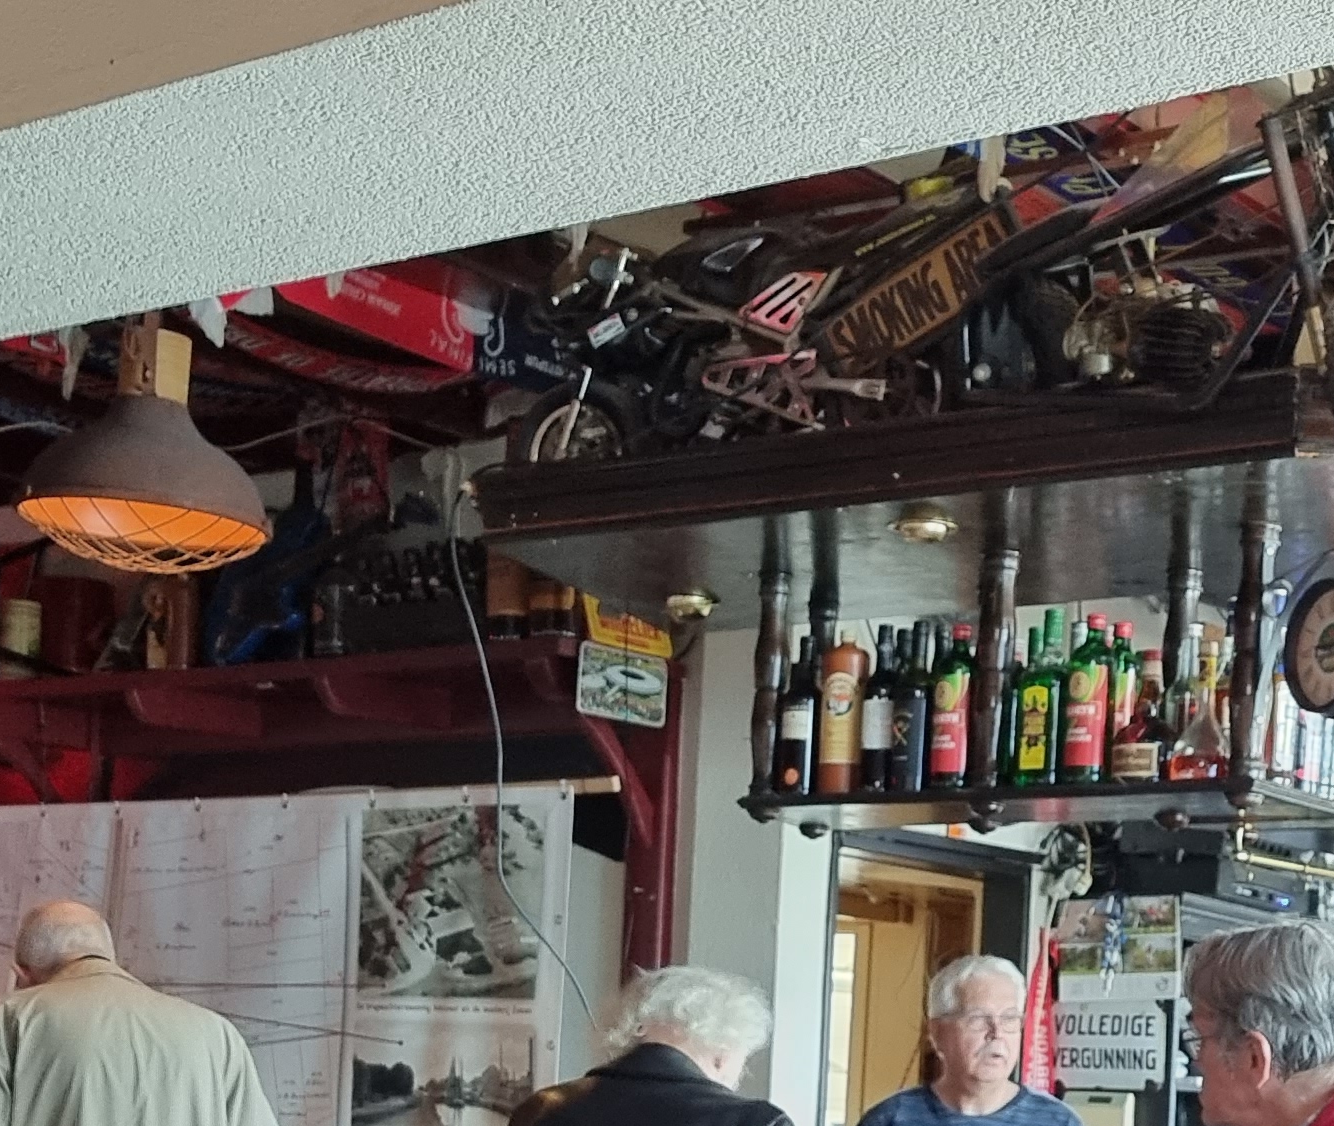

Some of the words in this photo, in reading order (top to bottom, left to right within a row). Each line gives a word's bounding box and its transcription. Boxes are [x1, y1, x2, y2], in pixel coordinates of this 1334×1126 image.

[830, 260, 953, 357] SMOKING
[478, 356, 517, 376] SEMI
[1055, 1013, 1157, 1037] VOLLEDIGE
